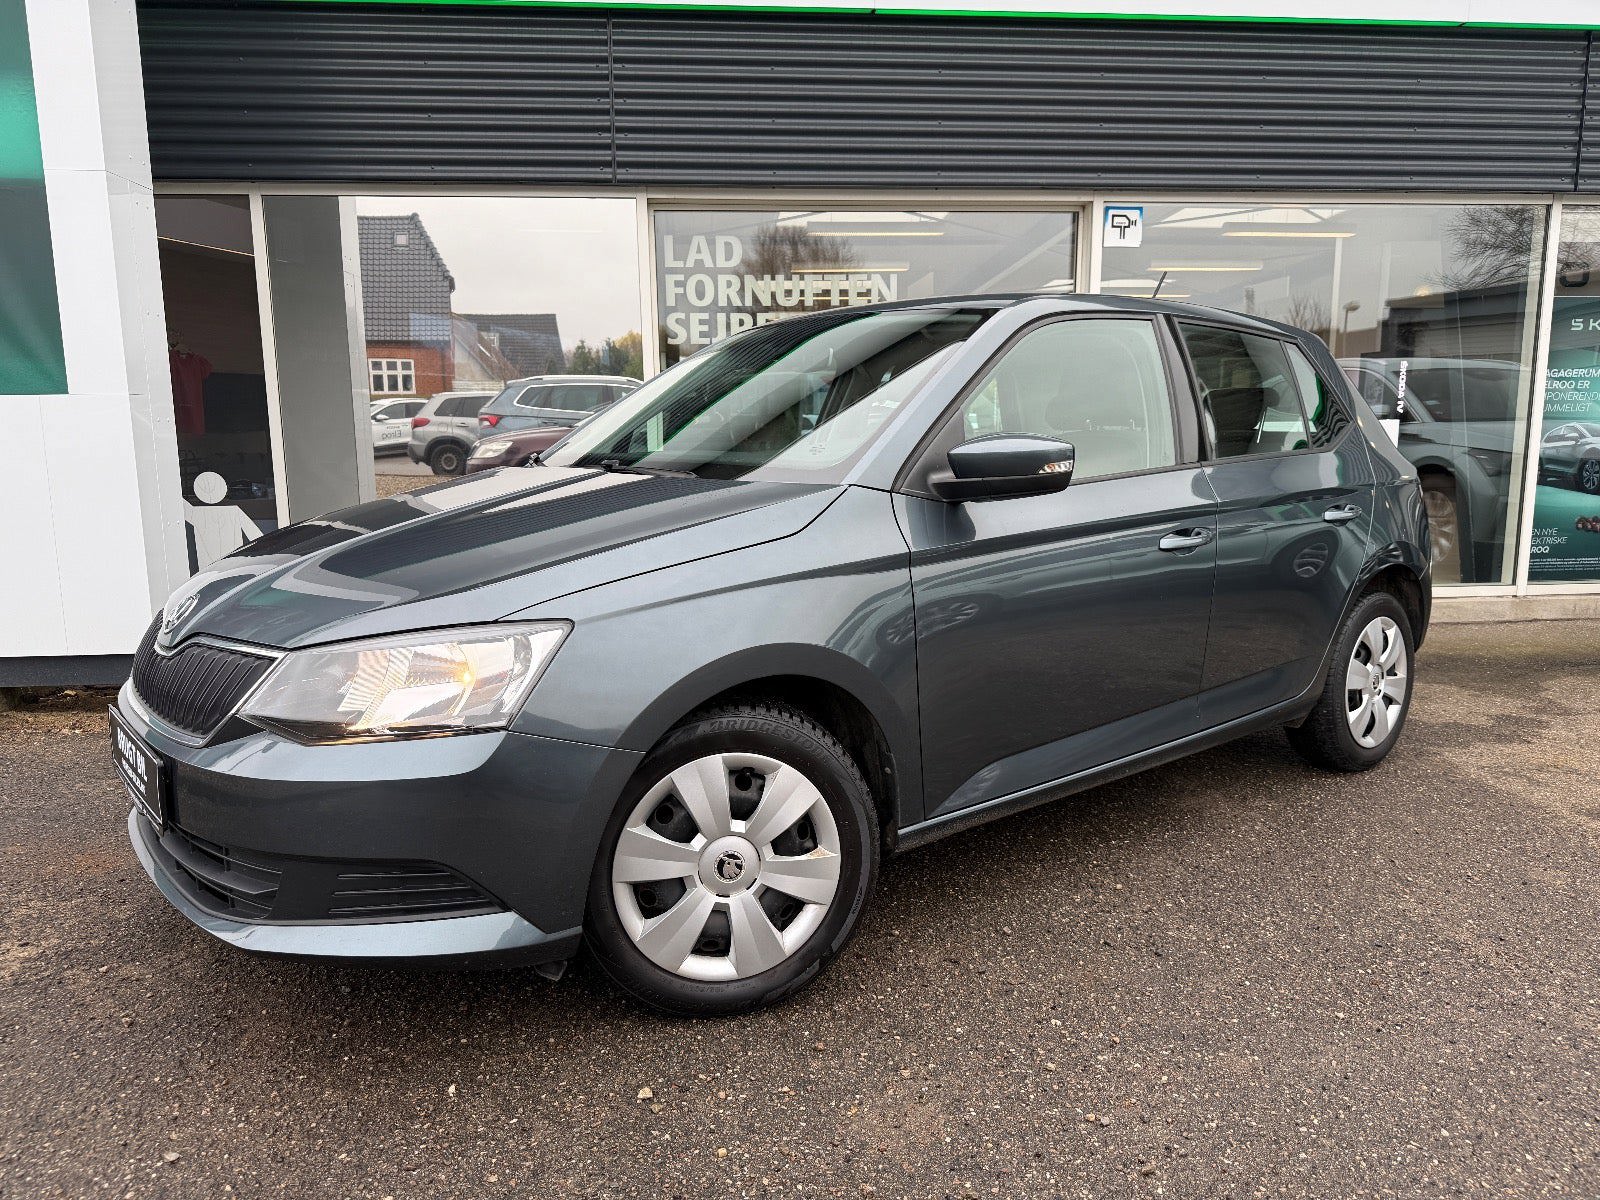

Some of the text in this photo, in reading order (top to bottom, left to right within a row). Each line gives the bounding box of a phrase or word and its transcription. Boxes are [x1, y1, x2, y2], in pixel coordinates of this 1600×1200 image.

[663, 234, 743, 268] LAD
[664, 273, 898, 307] FORNUFTEN
[1577, 380, 1591, 389] ER
[1544, 391, 1600, 401] PONEREND
[1541, 527, 1559, 536] NYE
[1530, 545, 1550, 554] ROQ
